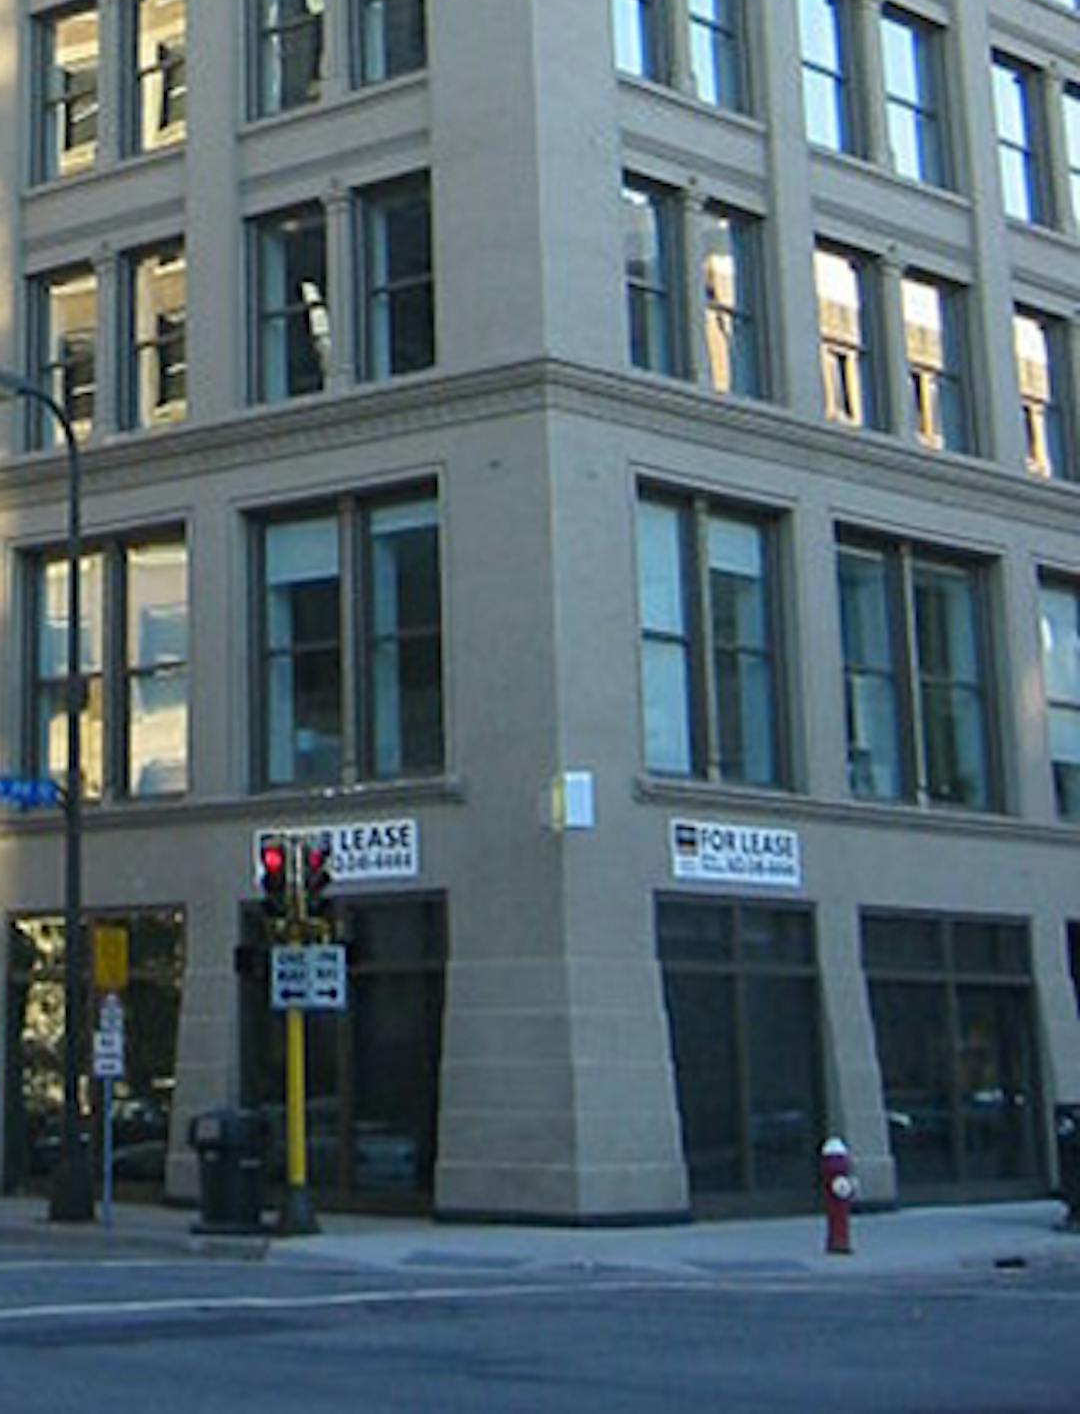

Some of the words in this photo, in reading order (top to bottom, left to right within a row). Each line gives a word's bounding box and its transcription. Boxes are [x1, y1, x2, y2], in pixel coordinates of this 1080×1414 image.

[340, 825, 411, 850] LEASE
[701, 828, 736, 852] FOR
[742, 832, 793, 858] LEASE
